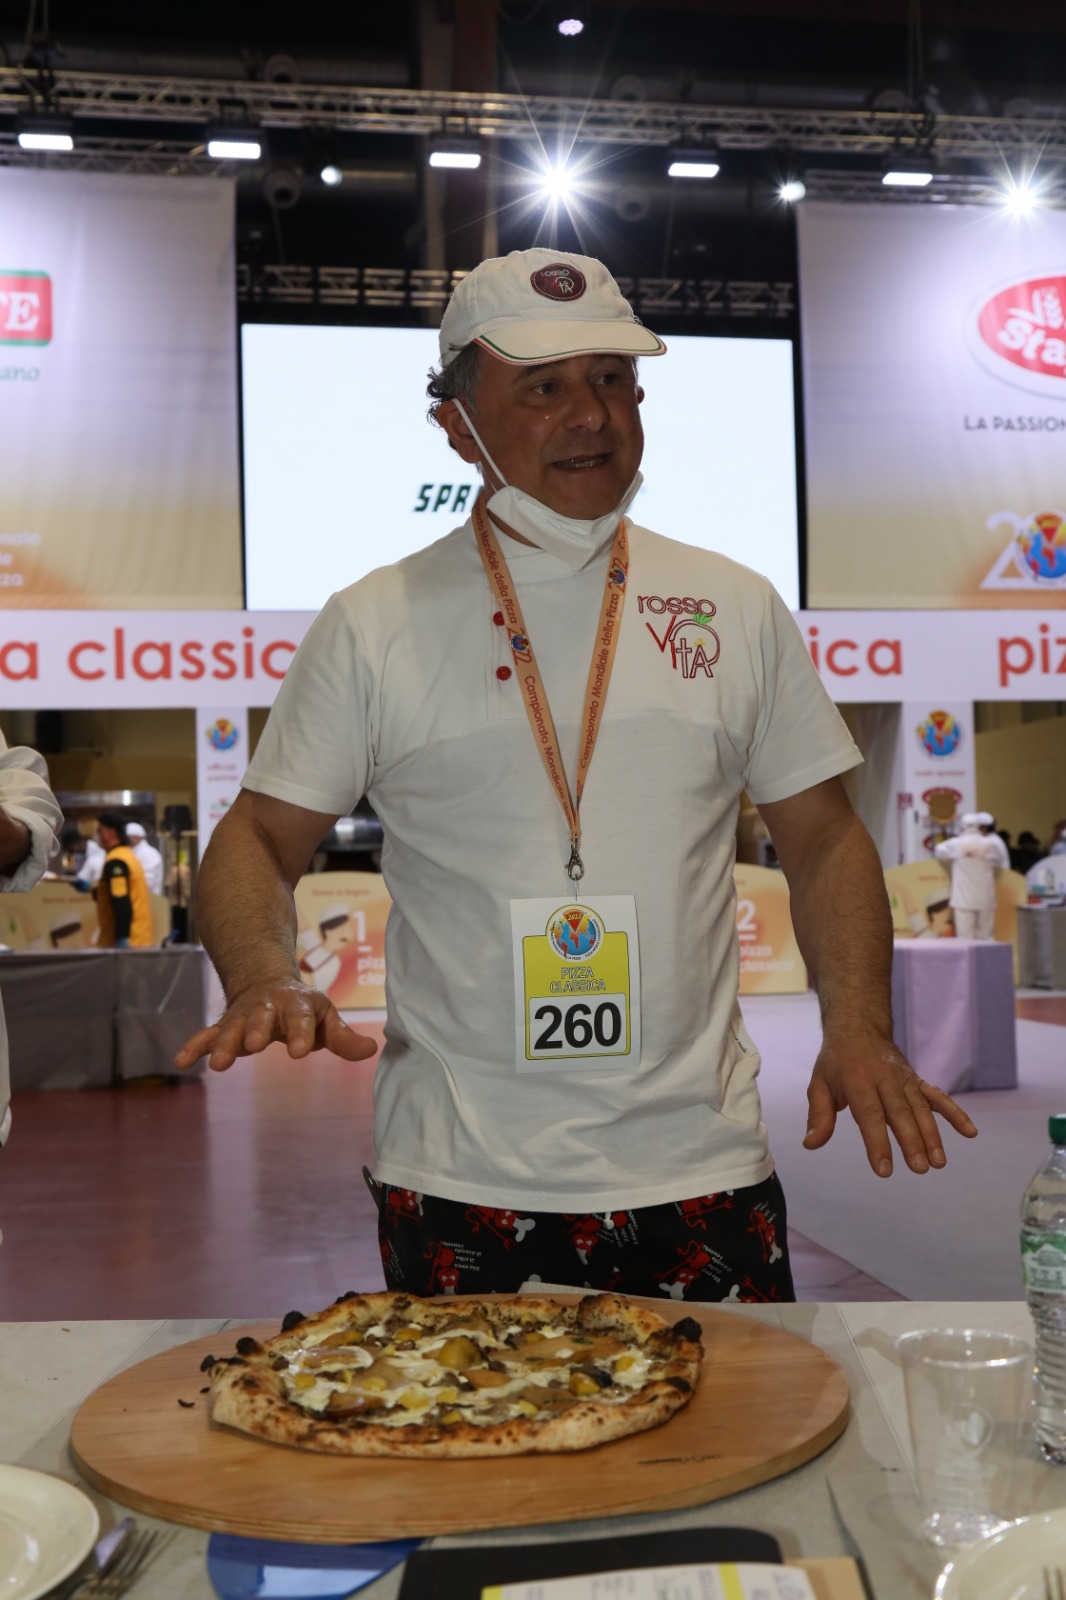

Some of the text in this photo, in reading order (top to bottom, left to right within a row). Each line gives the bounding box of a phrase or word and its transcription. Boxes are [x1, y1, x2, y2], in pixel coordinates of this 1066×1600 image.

[964, 415, 988, 431] LA
[413, 484, 483, 512] SPR
[494, 572, 508, 597] della
[502, 599, 517, 624] Pizza
[637, 595, 717, 617] rosso
[67, 626, 298, 681] classic
[580, 593, 619, 769] Campionato Mondiale della Pizza
[524, 675, 565, 799] Campionato Mondiale
[550, 979, 606, 993] CLASSICA
[561, 966, 594, 979] PIZZA
[533, 1002, 622, 1050] 260
